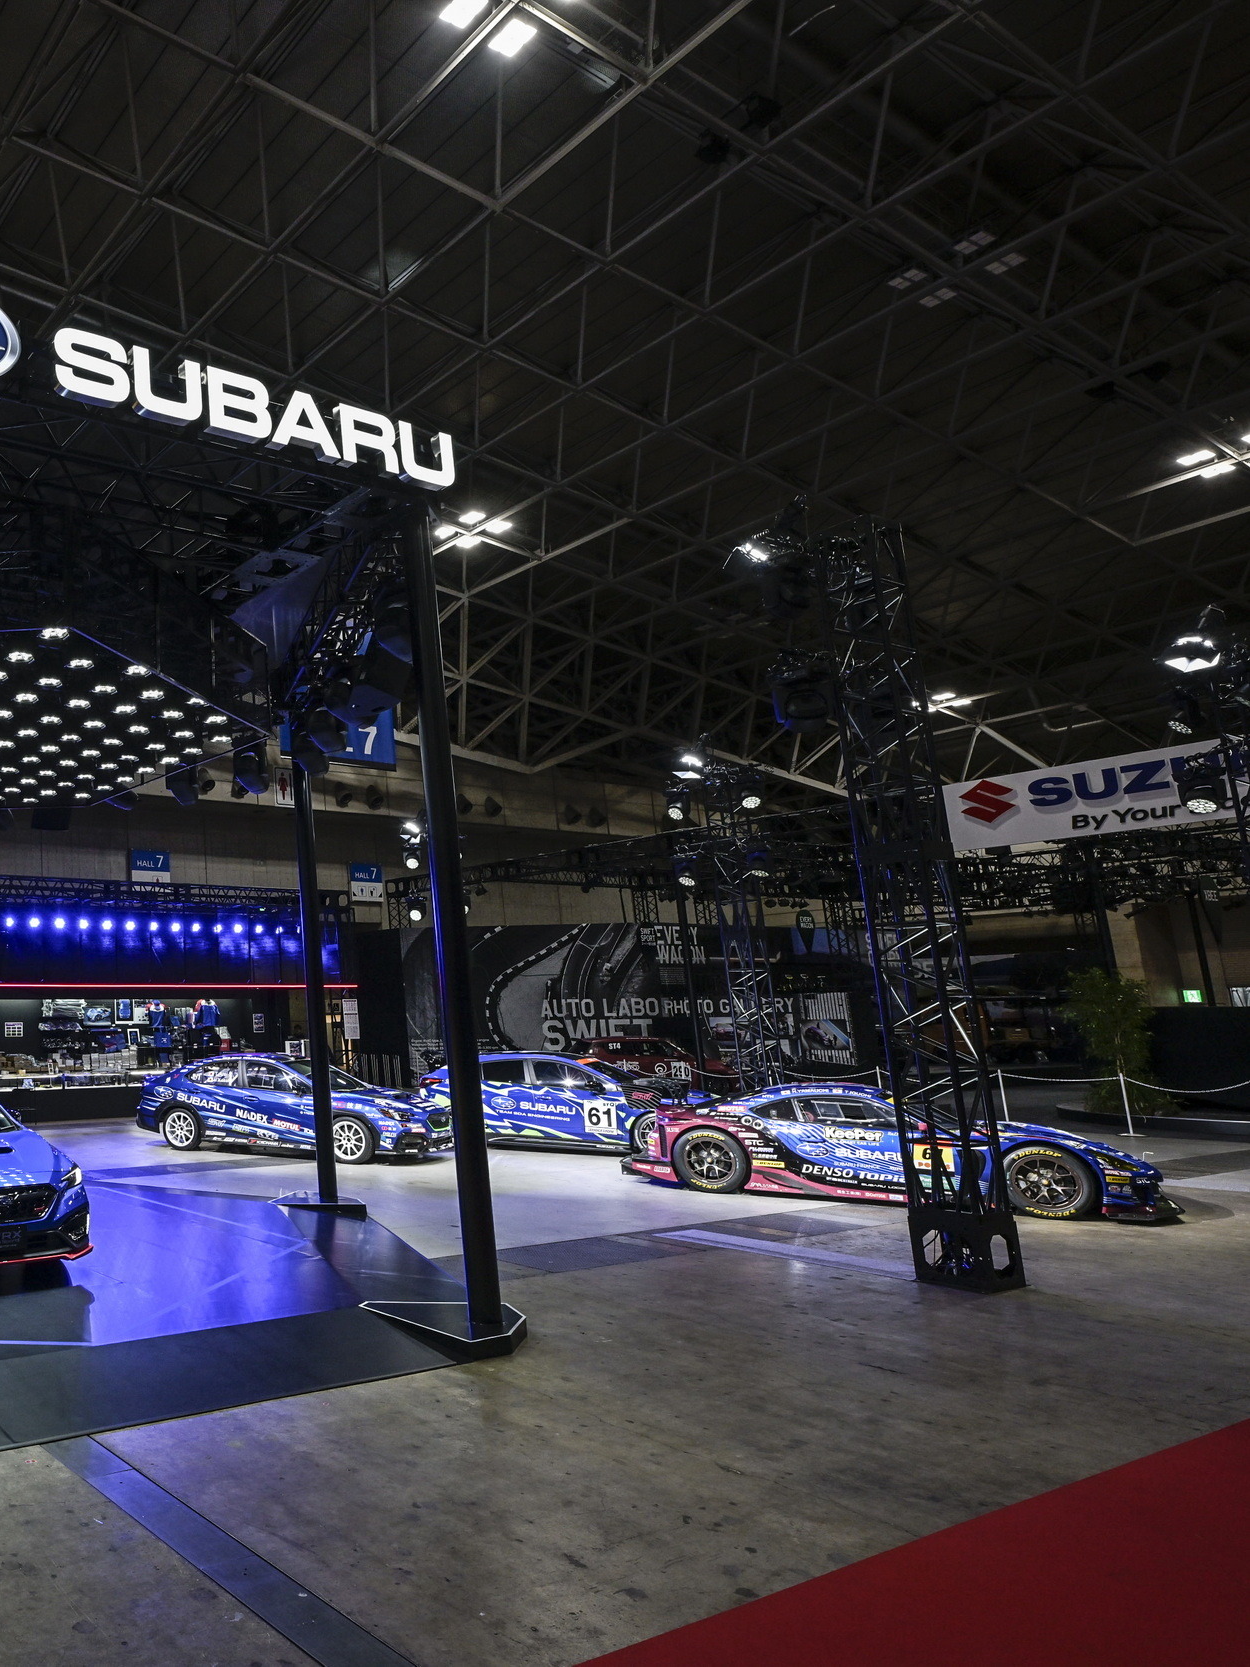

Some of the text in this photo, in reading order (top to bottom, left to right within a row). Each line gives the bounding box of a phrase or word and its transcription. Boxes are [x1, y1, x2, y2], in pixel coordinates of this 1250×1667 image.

[53, 327, 456, 489] SUBARU
[358, 726, 378, 755] 7
[1028, 752, 1247, 807] SUZ
[1071, 803, 1181, 830] By Your
[137, 856, 164, 868] HALL 7
[354, 868, 377, 879] HALL 7
[654, 925, 698, 945] EVEY
[541, 998, 659, 1018] AUTO LABO
[719, 998, 794, 1014] GAERY
[542, 1018, 653, 1051] SWIFT
[608, 1042, 621, 1050] ST4
[176, 1092, 226, 1113] SUBARU
[519, 1101, 576, 1115] SUBARU
[235, 1108, 269, 1124] NADEX
[527, 1113, 571, 1122] ENGINEERING
[587, 1107, 613, 1128] 61
[272, 1119, 300, 1131] MOTUL
[692, 1133, 725, 1141] DUNLOP
[825, 1126, 883, 1142] KeePer
[1019, 1149, 1063, 1158] DUNLOP
[802, 1163, 854, 1178] DENSO
[1025, 1206, 1070, 1218] DUNLOP
